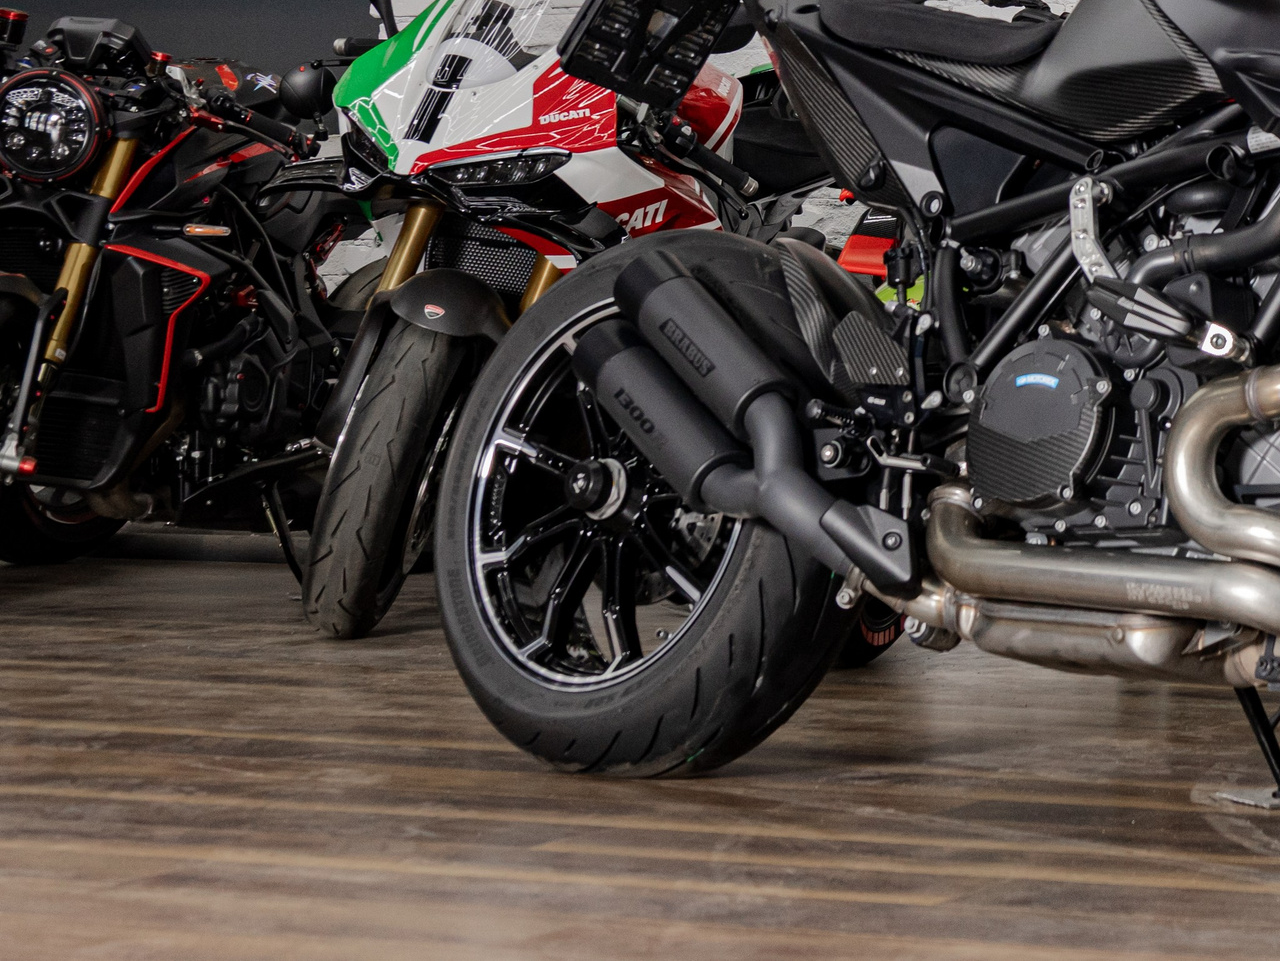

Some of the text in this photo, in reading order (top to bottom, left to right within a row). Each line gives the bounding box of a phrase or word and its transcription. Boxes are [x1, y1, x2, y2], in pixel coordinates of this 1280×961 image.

[539, 107, 591, 125] DUCATI
[614, 199, 668, 232] CATI
[662, 321, 714, 377] BRABUS
[613, 387, 656, 435] 1300
